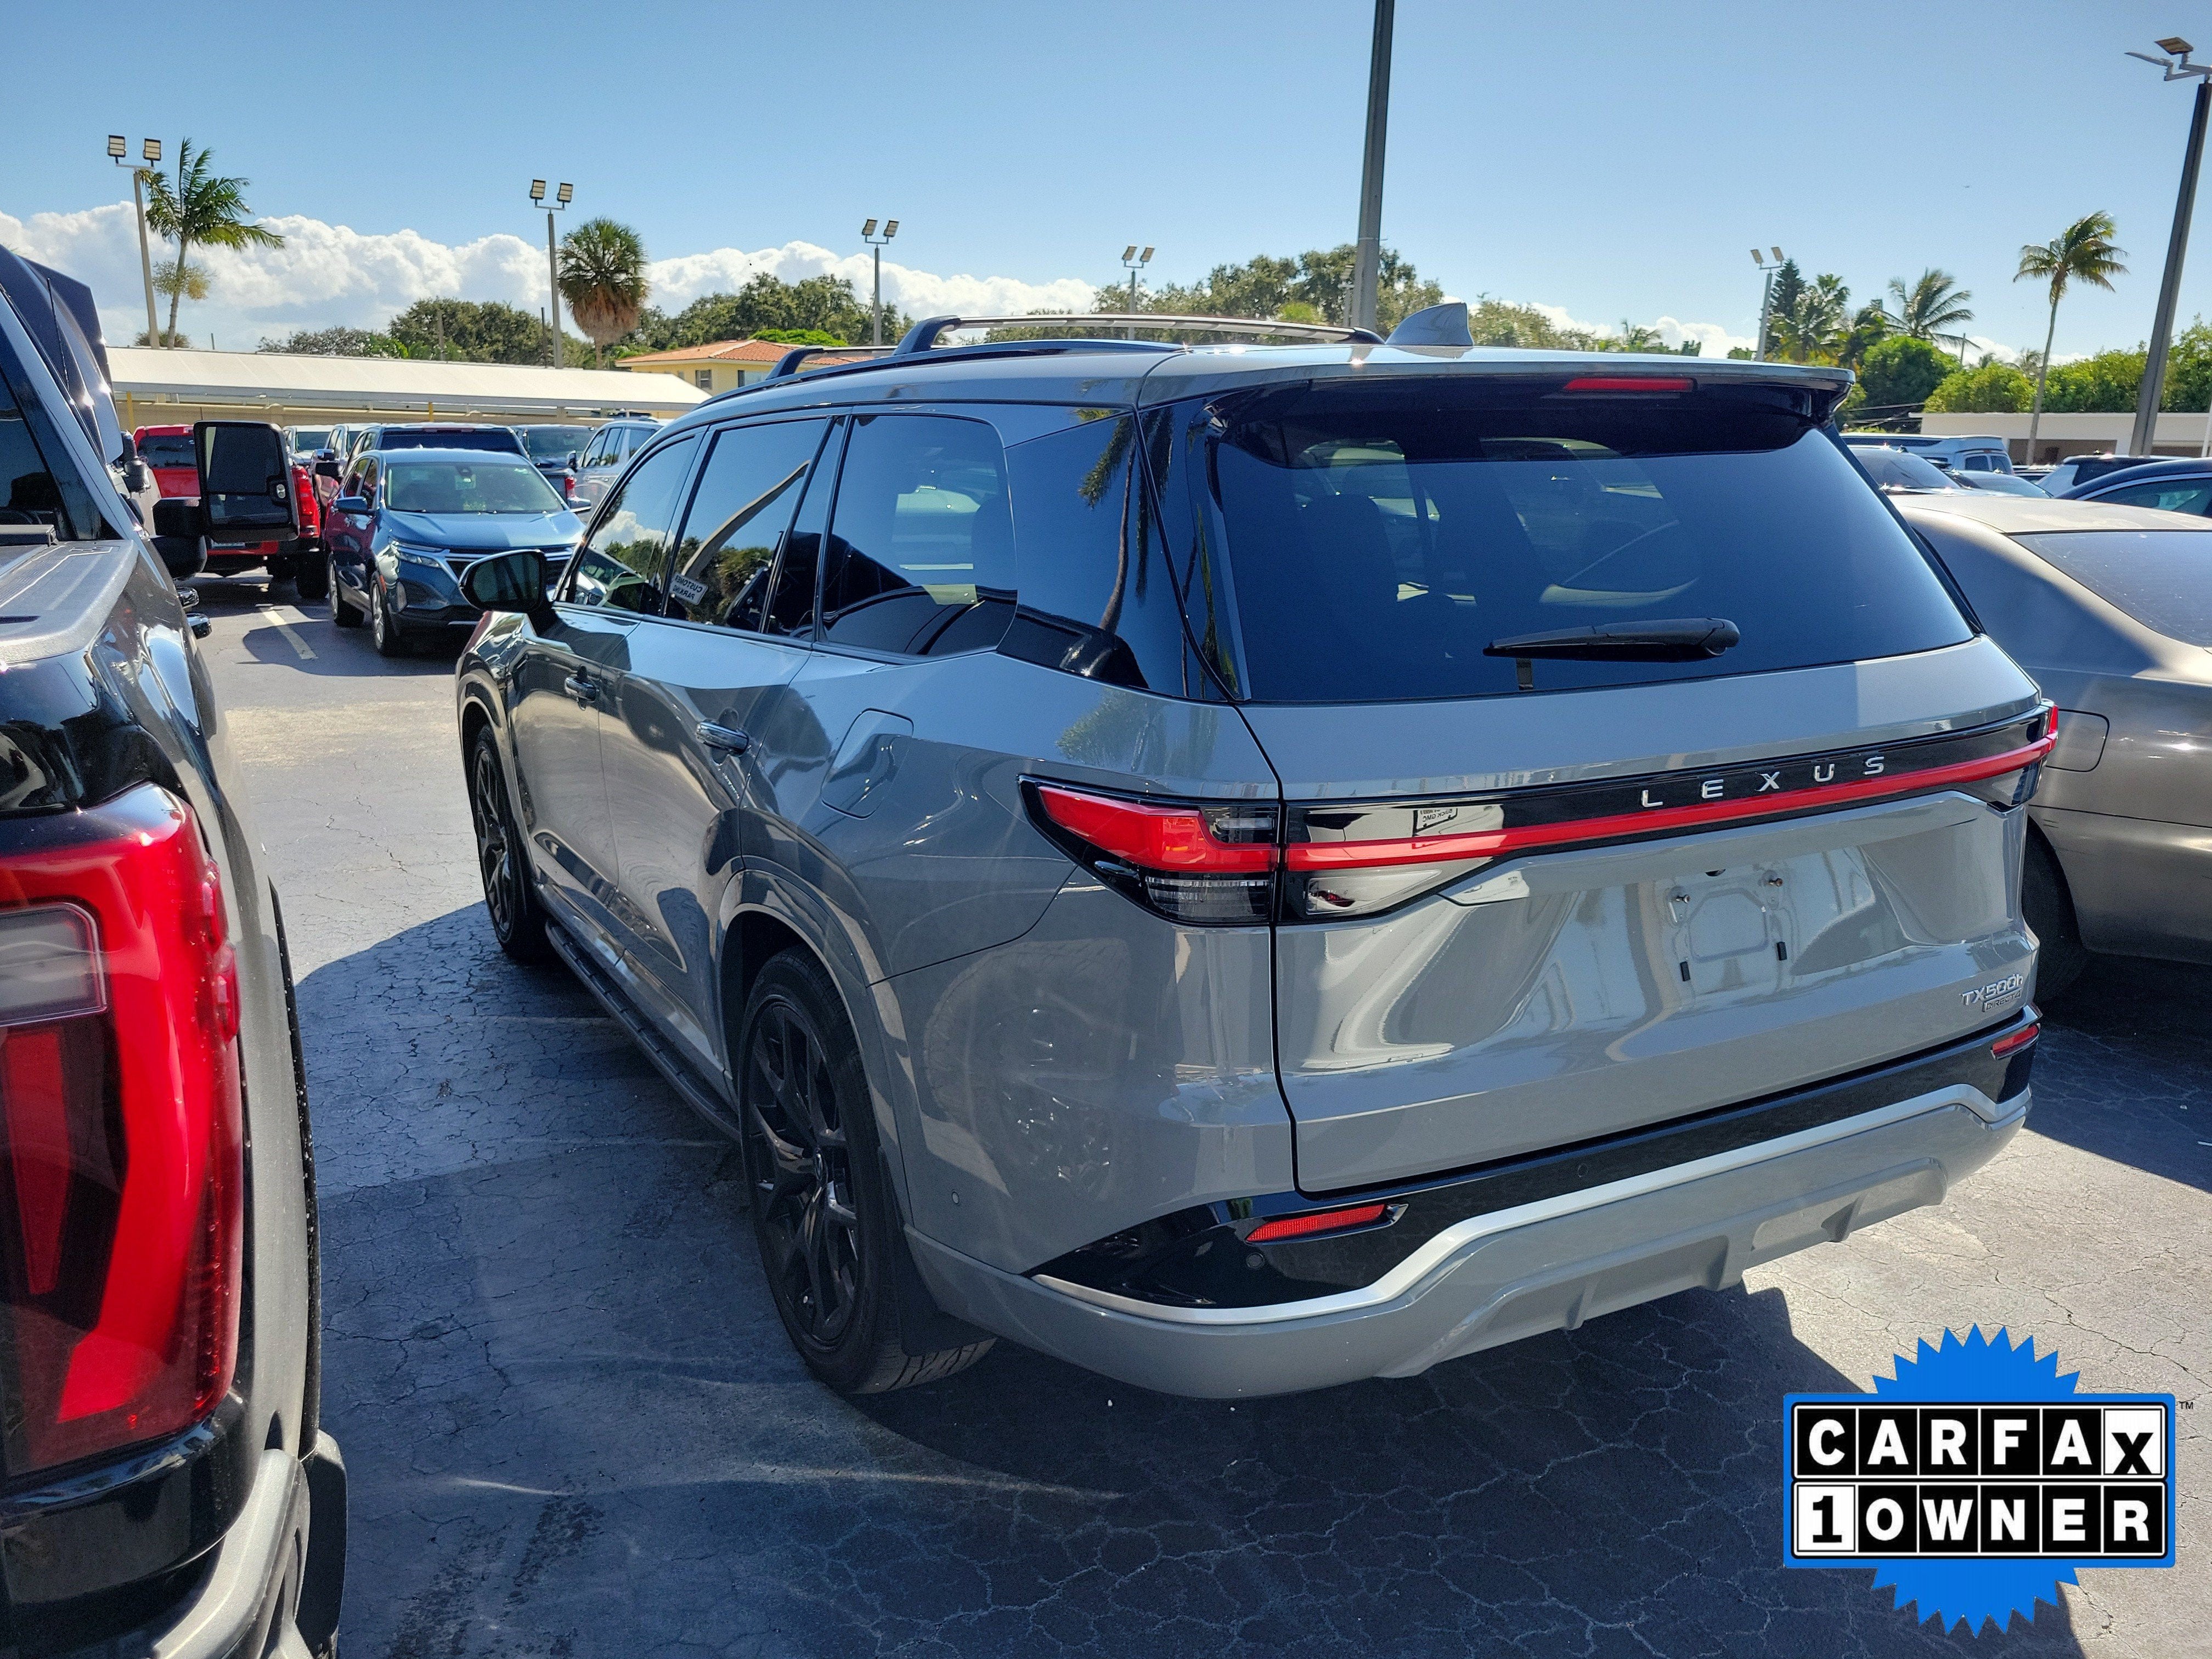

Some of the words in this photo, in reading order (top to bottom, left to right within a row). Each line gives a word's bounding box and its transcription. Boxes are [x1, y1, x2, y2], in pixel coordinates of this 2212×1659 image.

[1641, 756, 1884, 808] LEXUS
[1960, 974, 2023, 1005] TX500h
[1986, 990, 2021, 1011] DIRECT4
